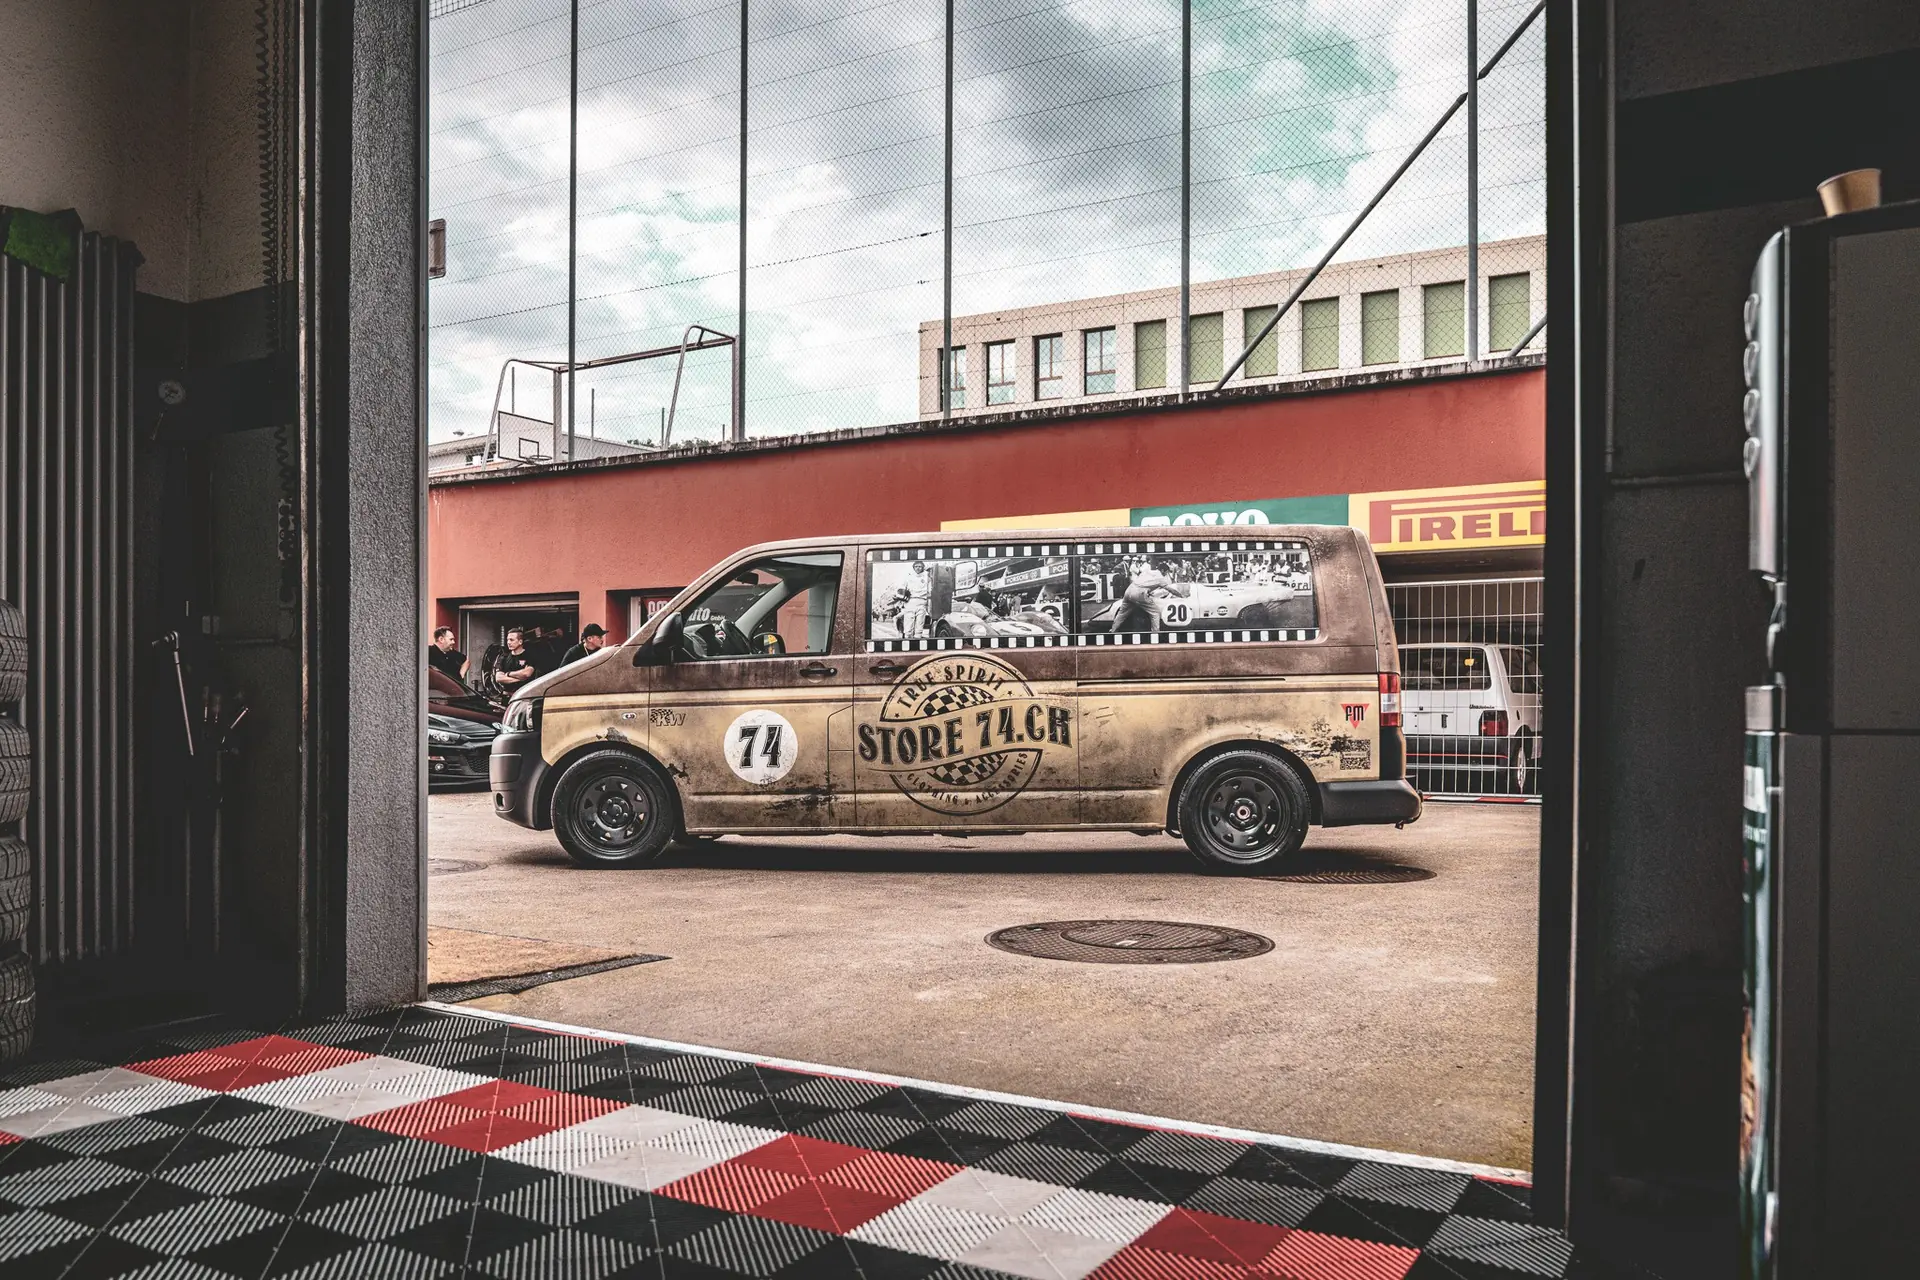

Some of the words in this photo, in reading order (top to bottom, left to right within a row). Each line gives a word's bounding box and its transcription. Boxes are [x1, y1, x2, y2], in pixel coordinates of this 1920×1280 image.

[1166, 604, 1188, 623] 20
[896, 674, 936, 709] TRUE
[944, 664, 1004, 692] SPIRIT
[738, 724, 784, 769] 74
[858, 716, 964, 766] STORE
[976, 703, 1073, 749] 74.CH
[906, 772, 959, 806] CLOTHING
[975, 752, 1028, 805] ACCESSORIES
